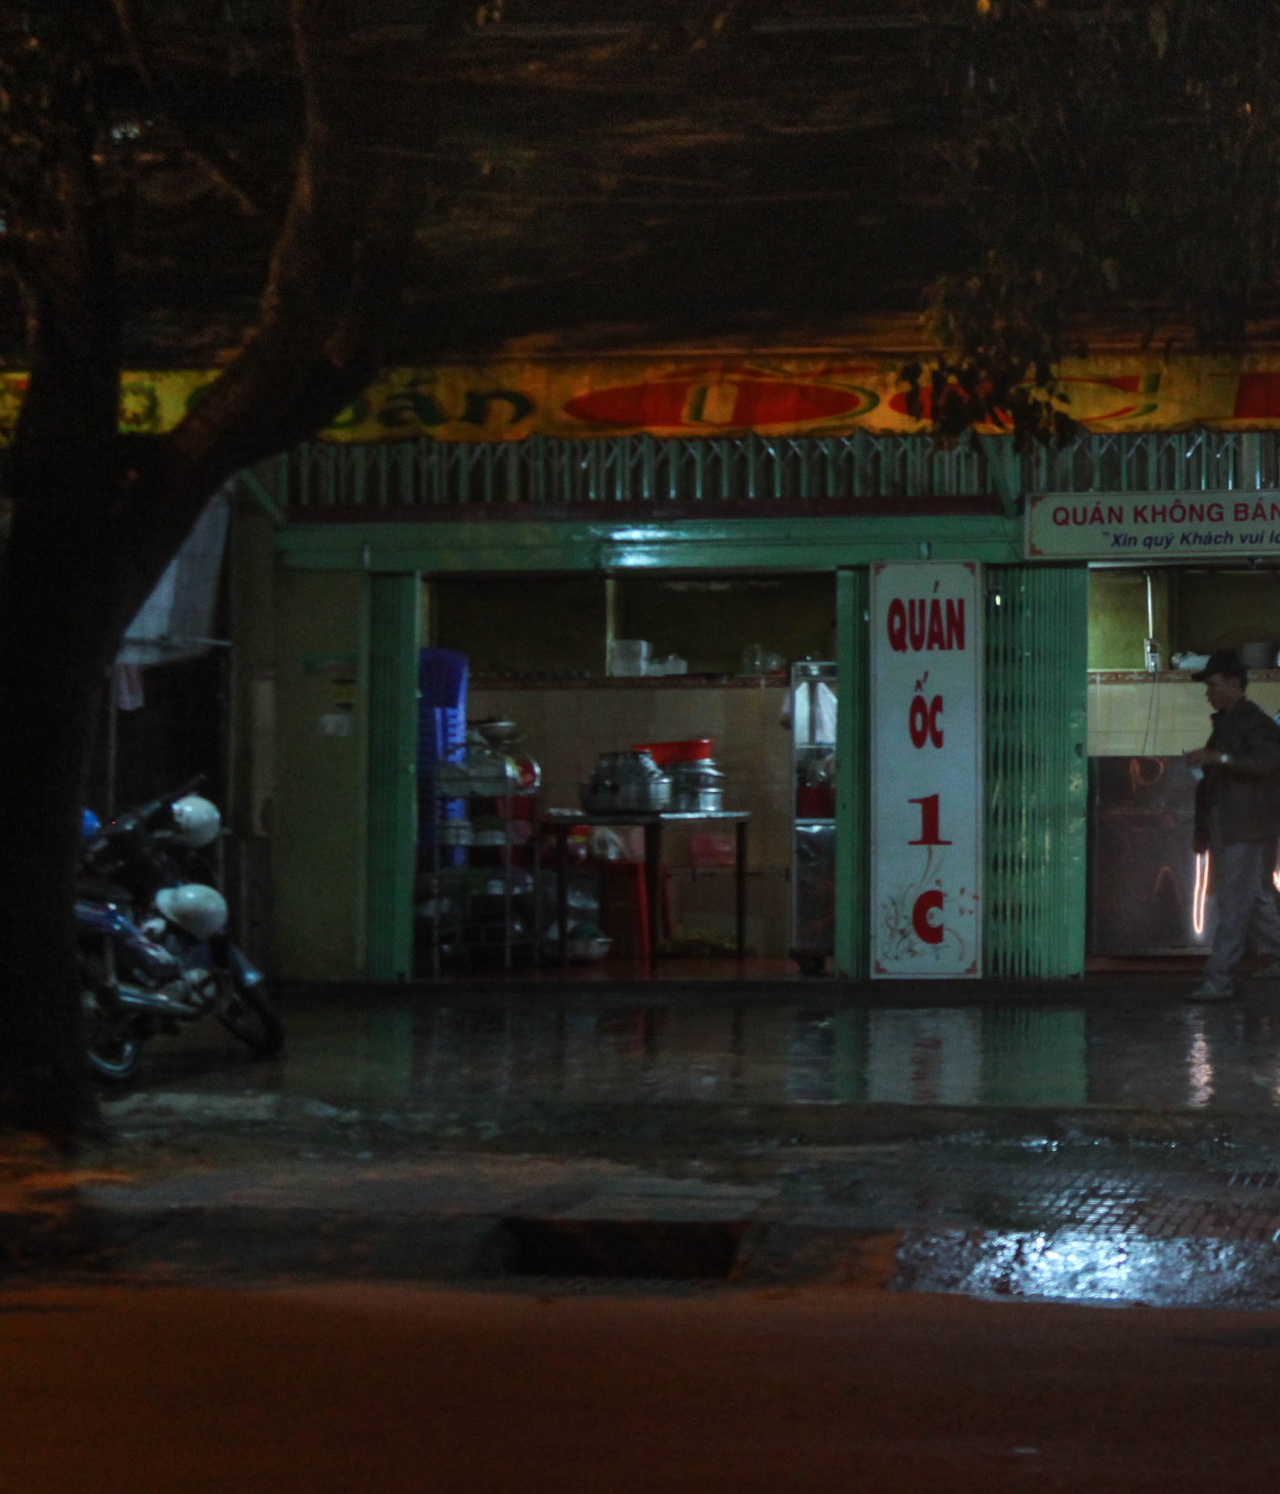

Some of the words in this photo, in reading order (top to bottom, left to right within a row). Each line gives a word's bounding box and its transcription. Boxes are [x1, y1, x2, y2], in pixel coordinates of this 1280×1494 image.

[1053, 500, 1124, 526] QUÁN
[1133, 499, 1224, 525] KHÔNG
[1143, 531, 1174, 549] quý
[1180, 531, 1234, 546] Khách
[1240, 530, 1265, 544] vui
[887, 581, 966, 652] QUÁN
[909, 671, 944, 749] ỐC
[908, 794, 953, 846] 1
[912, 890, 945, 944] C
